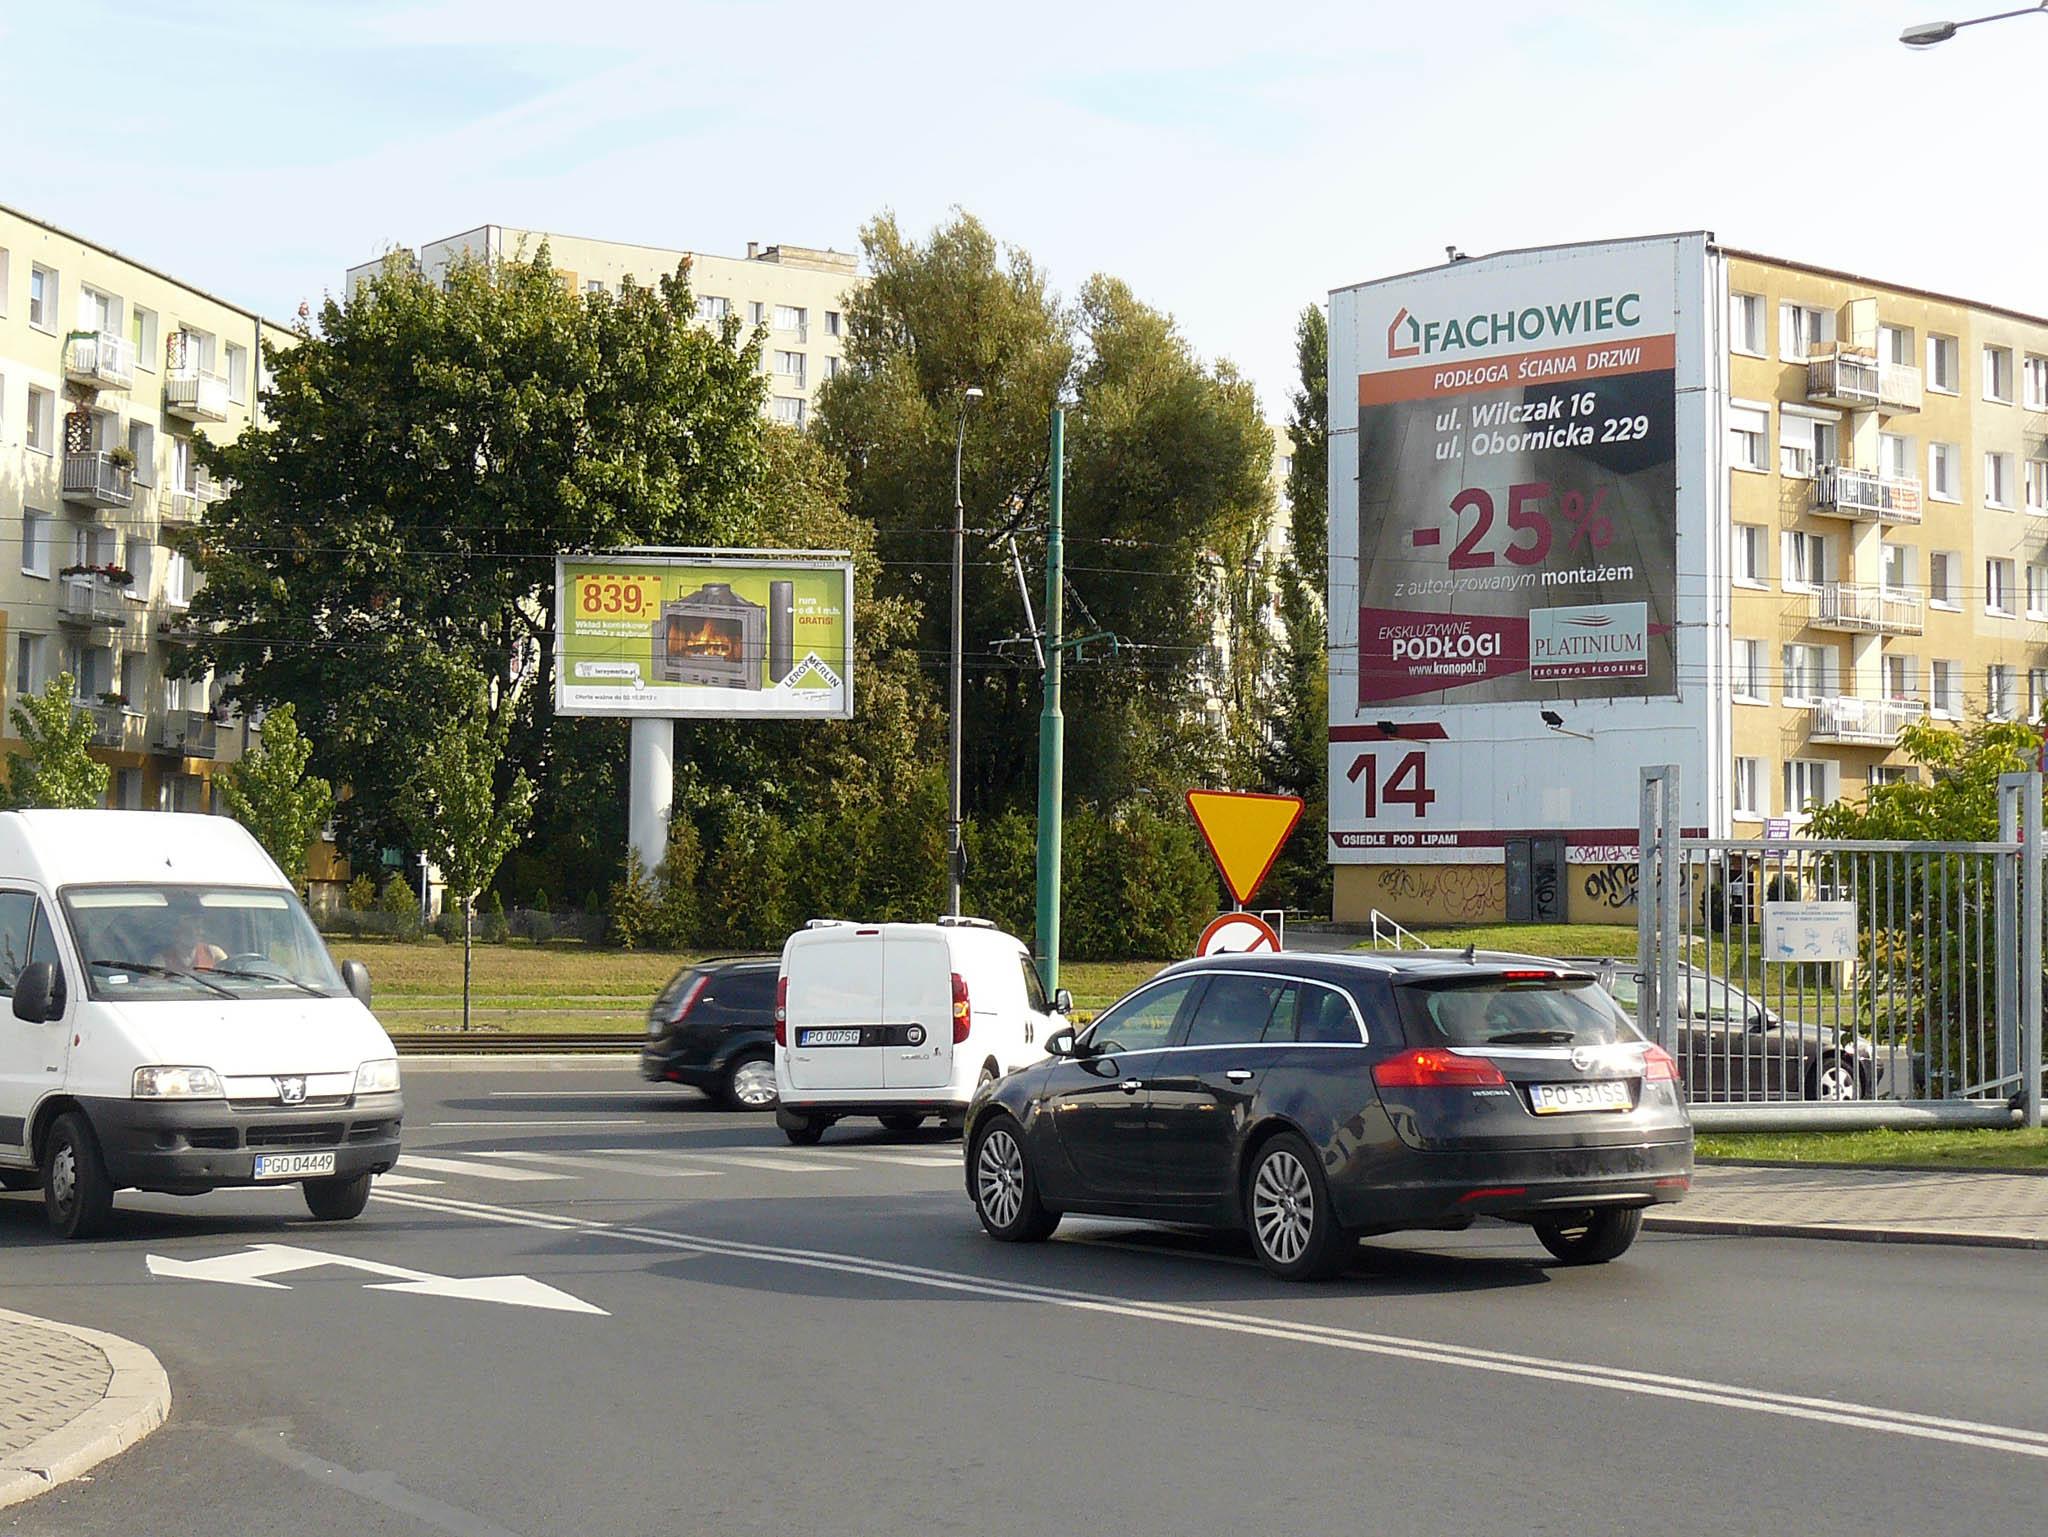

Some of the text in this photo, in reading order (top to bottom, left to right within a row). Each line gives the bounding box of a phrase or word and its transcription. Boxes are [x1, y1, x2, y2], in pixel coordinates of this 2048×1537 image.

[1424, 293, 1641, 354] FACHOWIEC
[1434, 347, 1642, 390] PODŁOGA ŚCIANA DRZWI
[1435, 391, 1597, 432] ul. Wilczak 16
[1435, 415, 1649, 460] ul. Obornicka 229
[1394, 564, 1634, 597] z autoryzowanym montażem
[1379, 621, 1472, 640] EKSKLUZYWNE
[1392, 633, 1501, 661] PODŁOGI
[1535, 633, 1642, 657] PLATINIUM
[785, 655, 840, 688] LEROY MERLIN
[1408, 659, 1487, 676] www.kronopol.pl
[1533, 664, 1643, 677] KRONOPOL FLOORING
[1346, 751, 1436, 819] 14
[1342, 834, 1458, 846] OSIEDLE POD LIPAMI
[808, 1030, 858, 1042] PO 007SG
[1543, 1086, 1569, 1105] PO
[263, 1153, 333, 1173] PGO 04449
